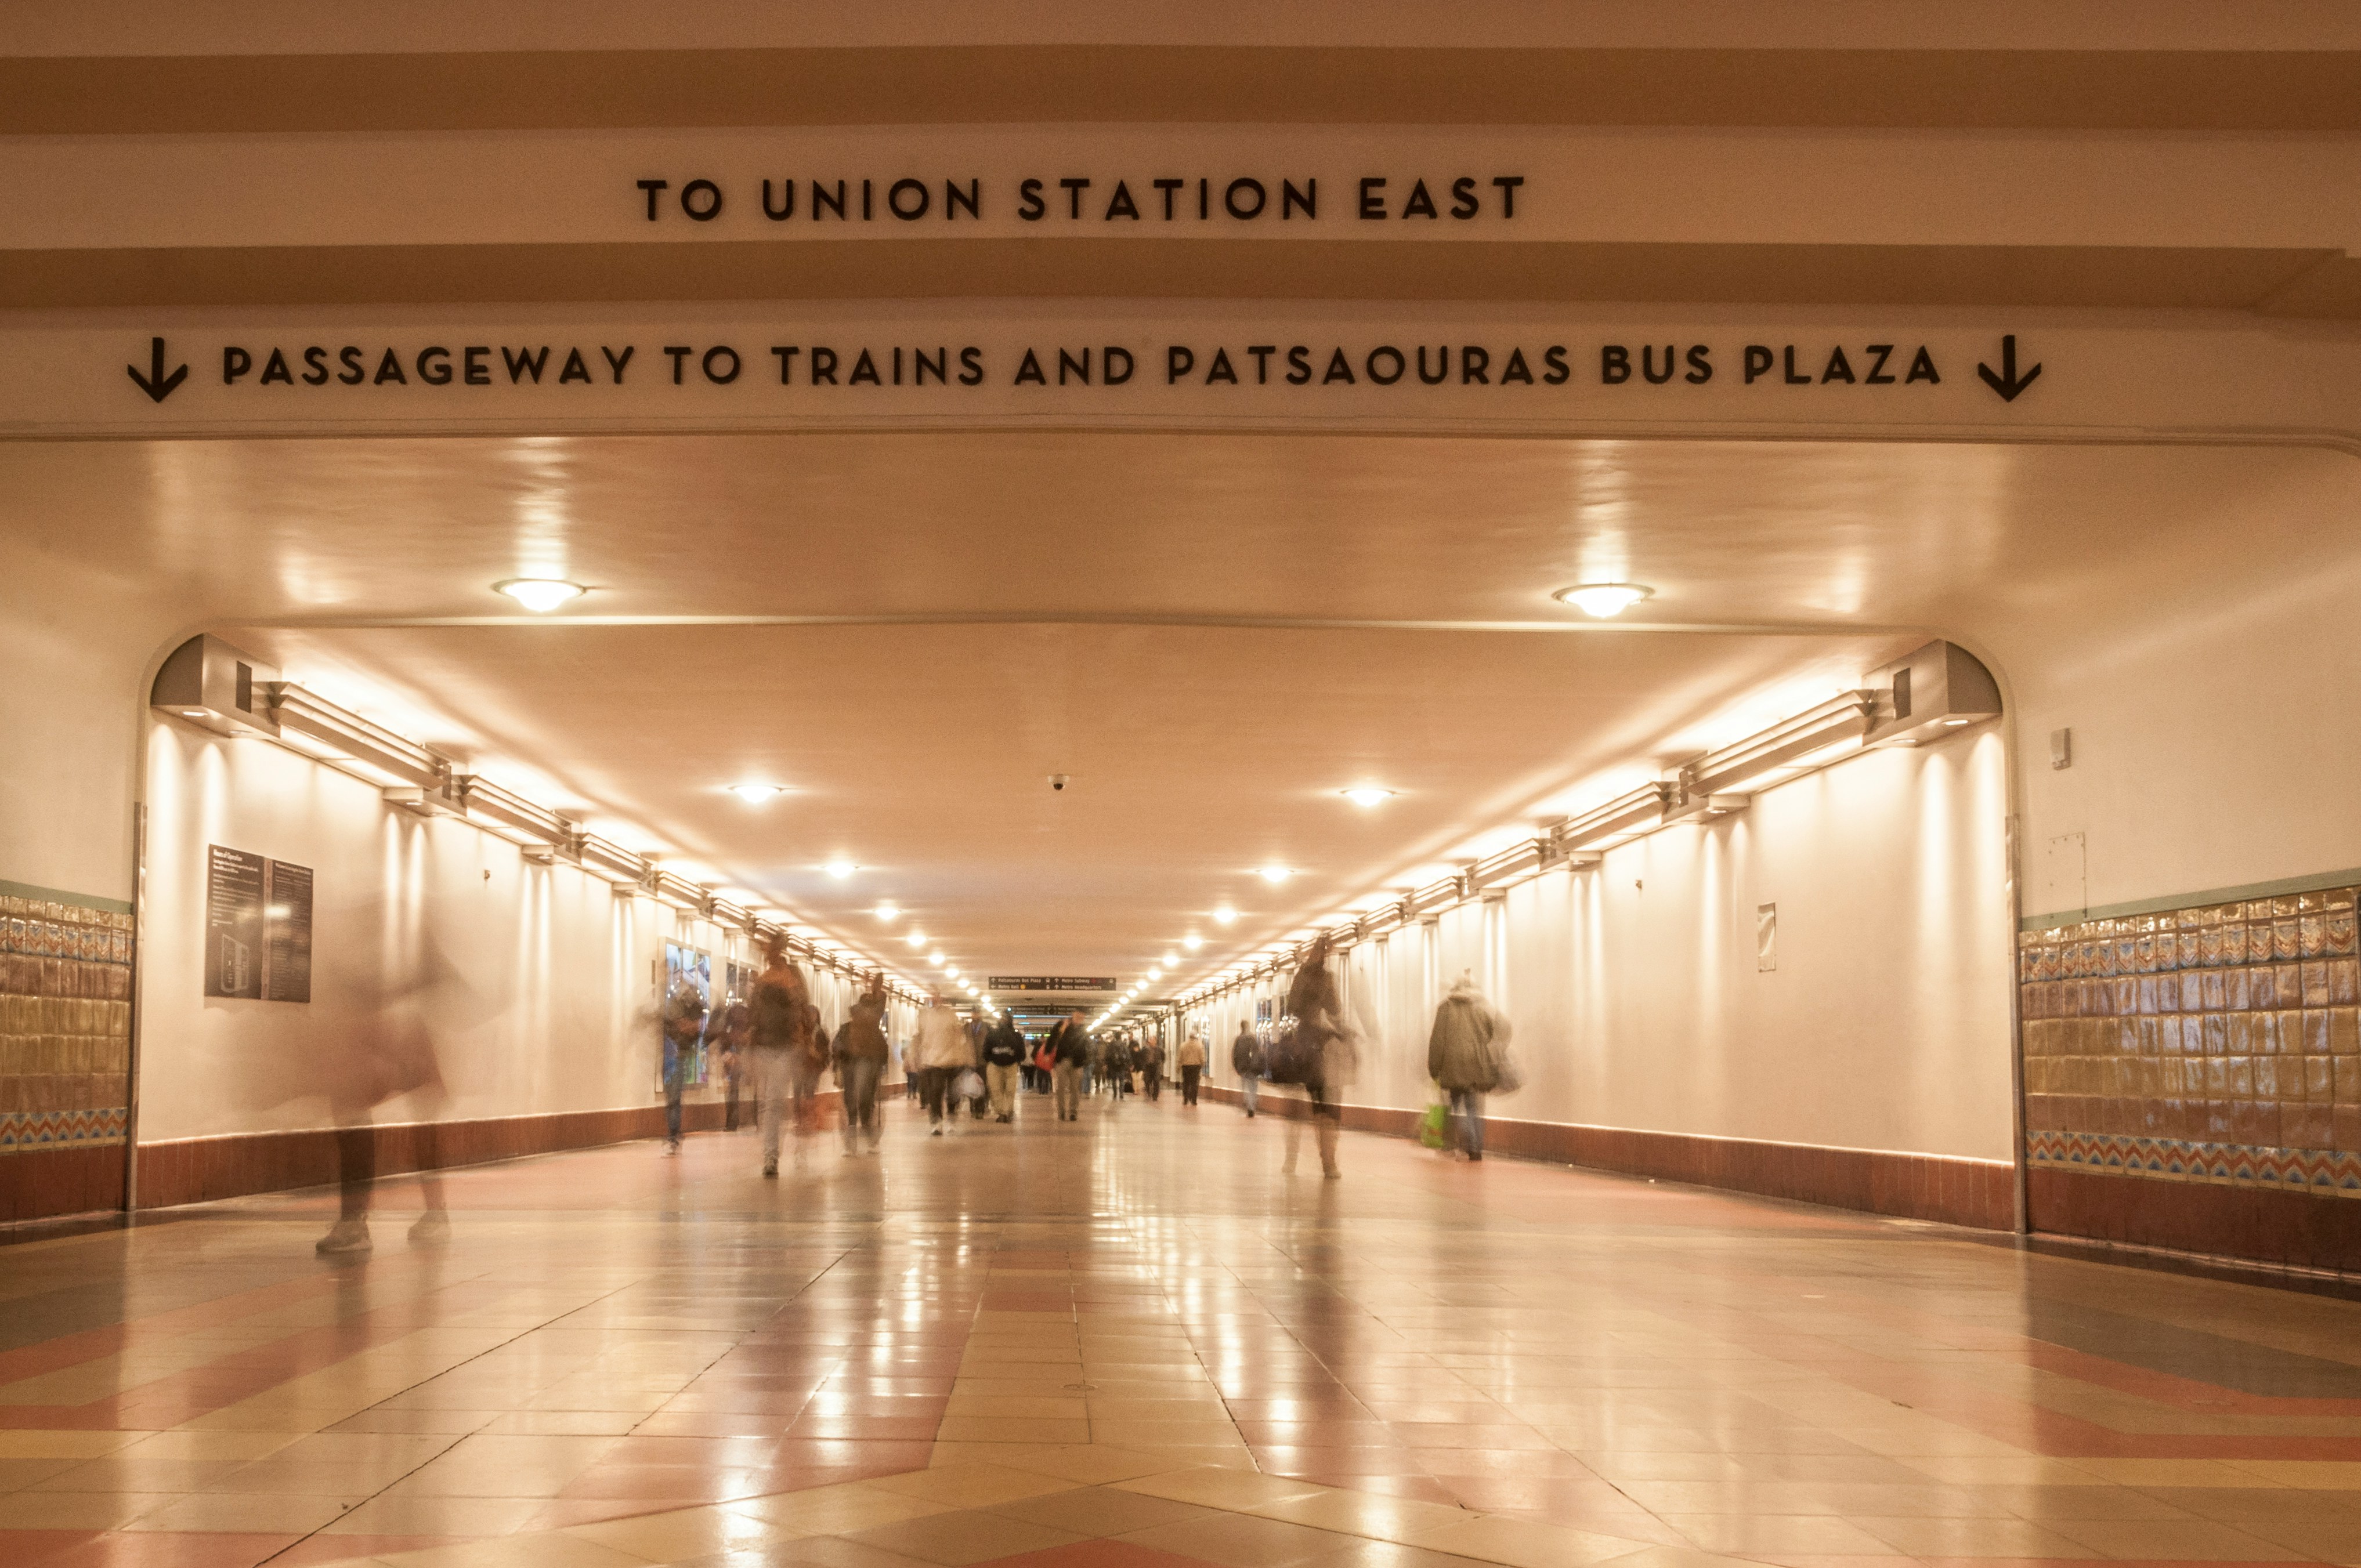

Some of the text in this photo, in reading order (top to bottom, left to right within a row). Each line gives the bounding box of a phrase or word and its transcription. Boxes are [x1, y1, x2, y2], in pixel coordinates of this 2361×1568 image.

[636, 175, 1525, 222] TO UNION STATION EAST
[222, 344, 1941, 387] PASSAGEWAY TO TRAINS AND PATSAOURAS BUS PLAZA
